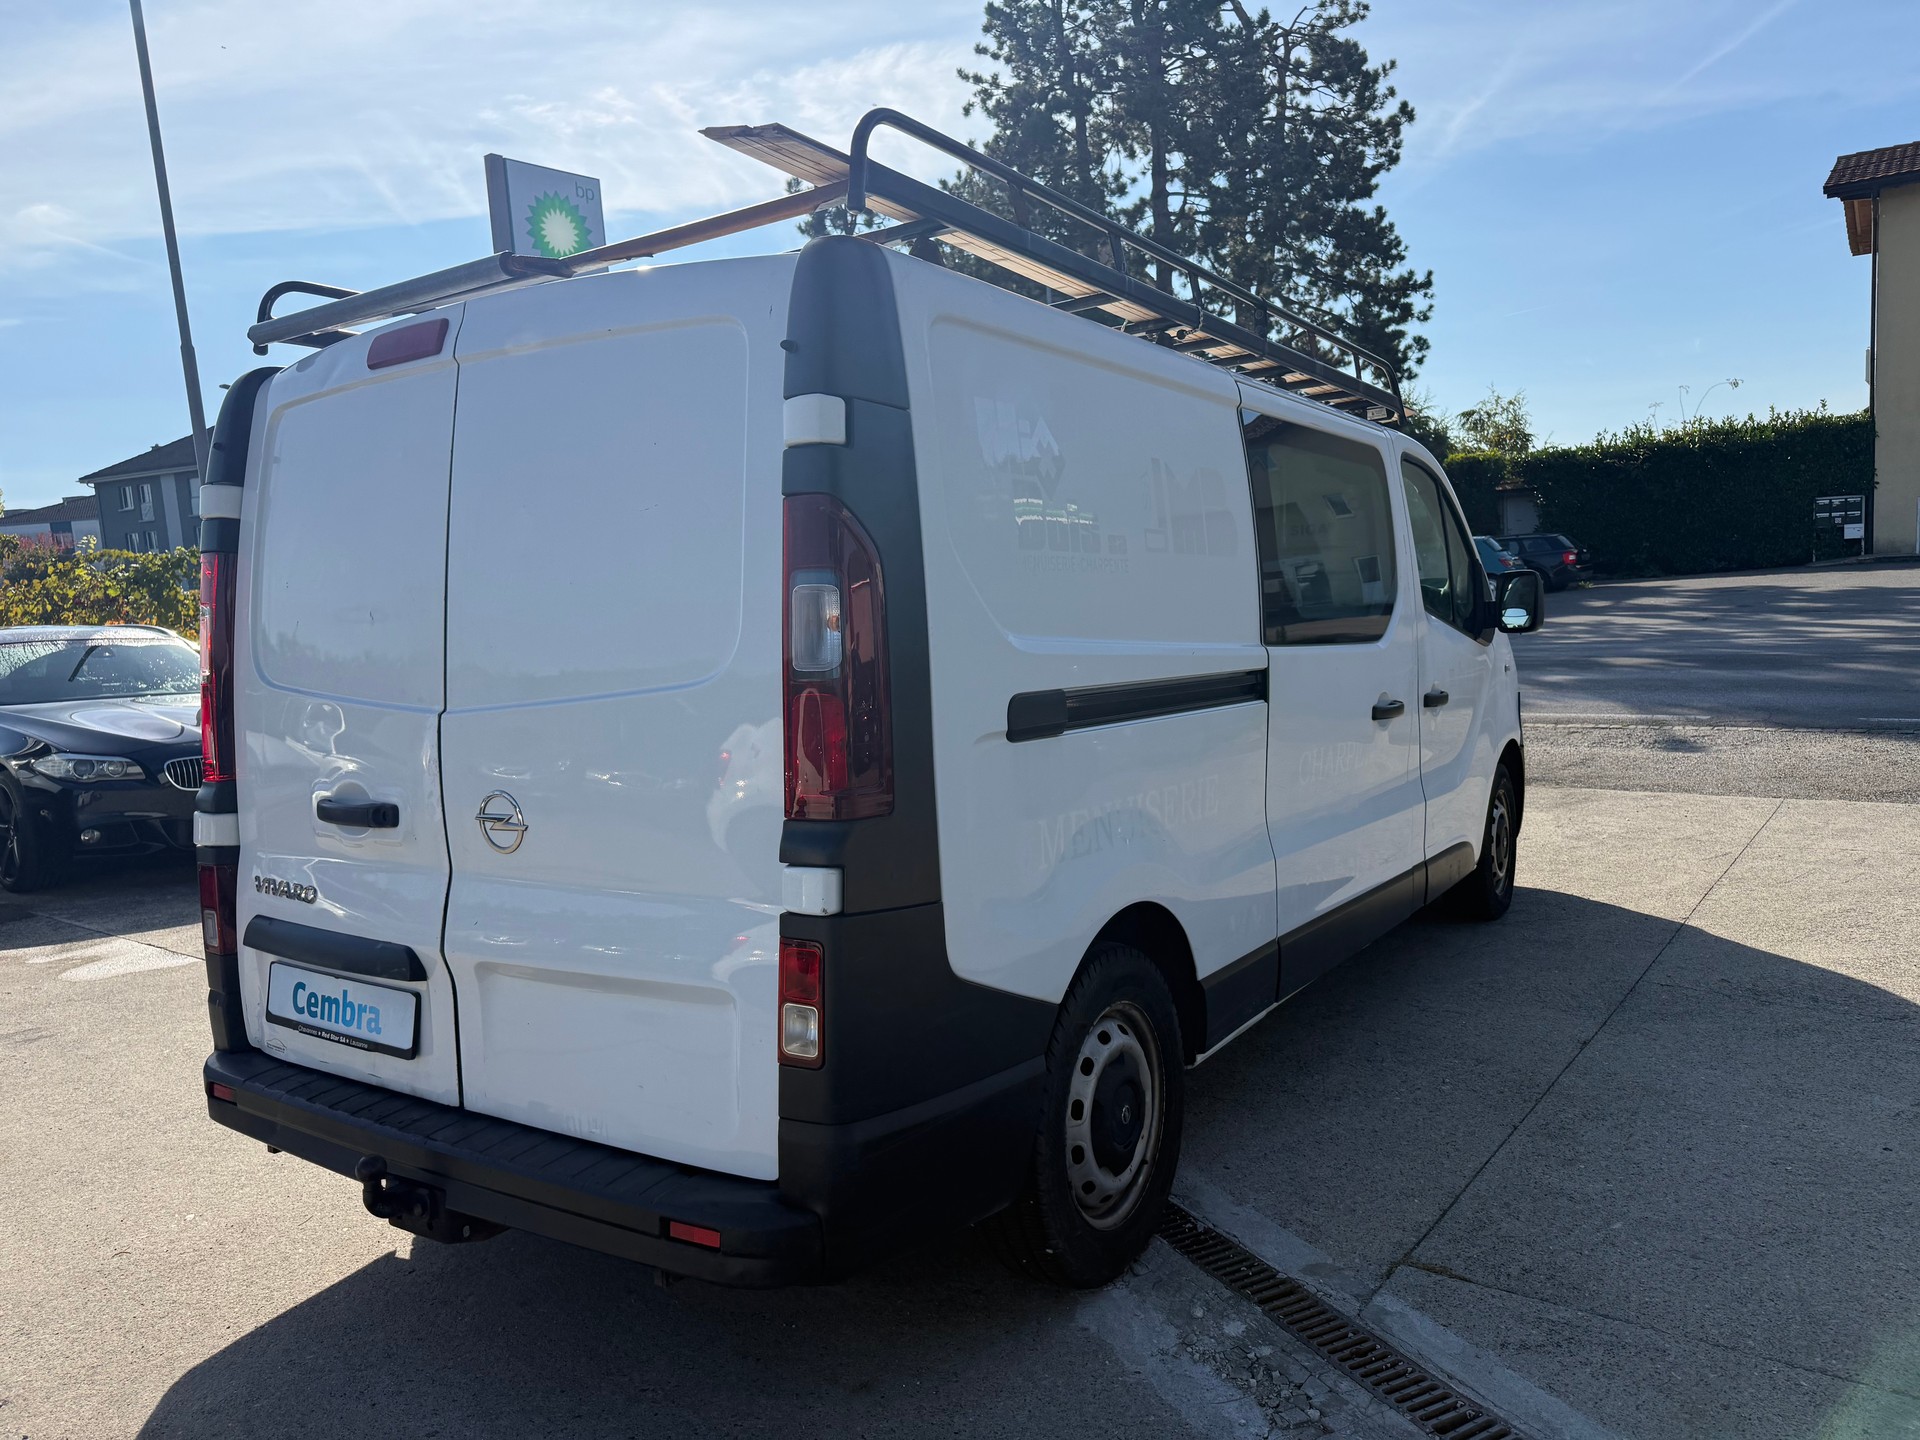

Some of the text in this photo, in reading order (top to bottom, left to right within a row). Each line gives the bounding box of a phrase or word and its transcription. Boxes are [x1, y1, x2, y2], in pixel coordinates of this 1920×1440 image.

[574, 181, 595, 203] bp
[255, 876, 318, 905] VIVARO
[292, 981, 382, 1035] Cembra
[321, 1031, 330, 1039] Red
[330, 1033, 340, 1041] Star
[340, 1035, 346, 1043] SA
